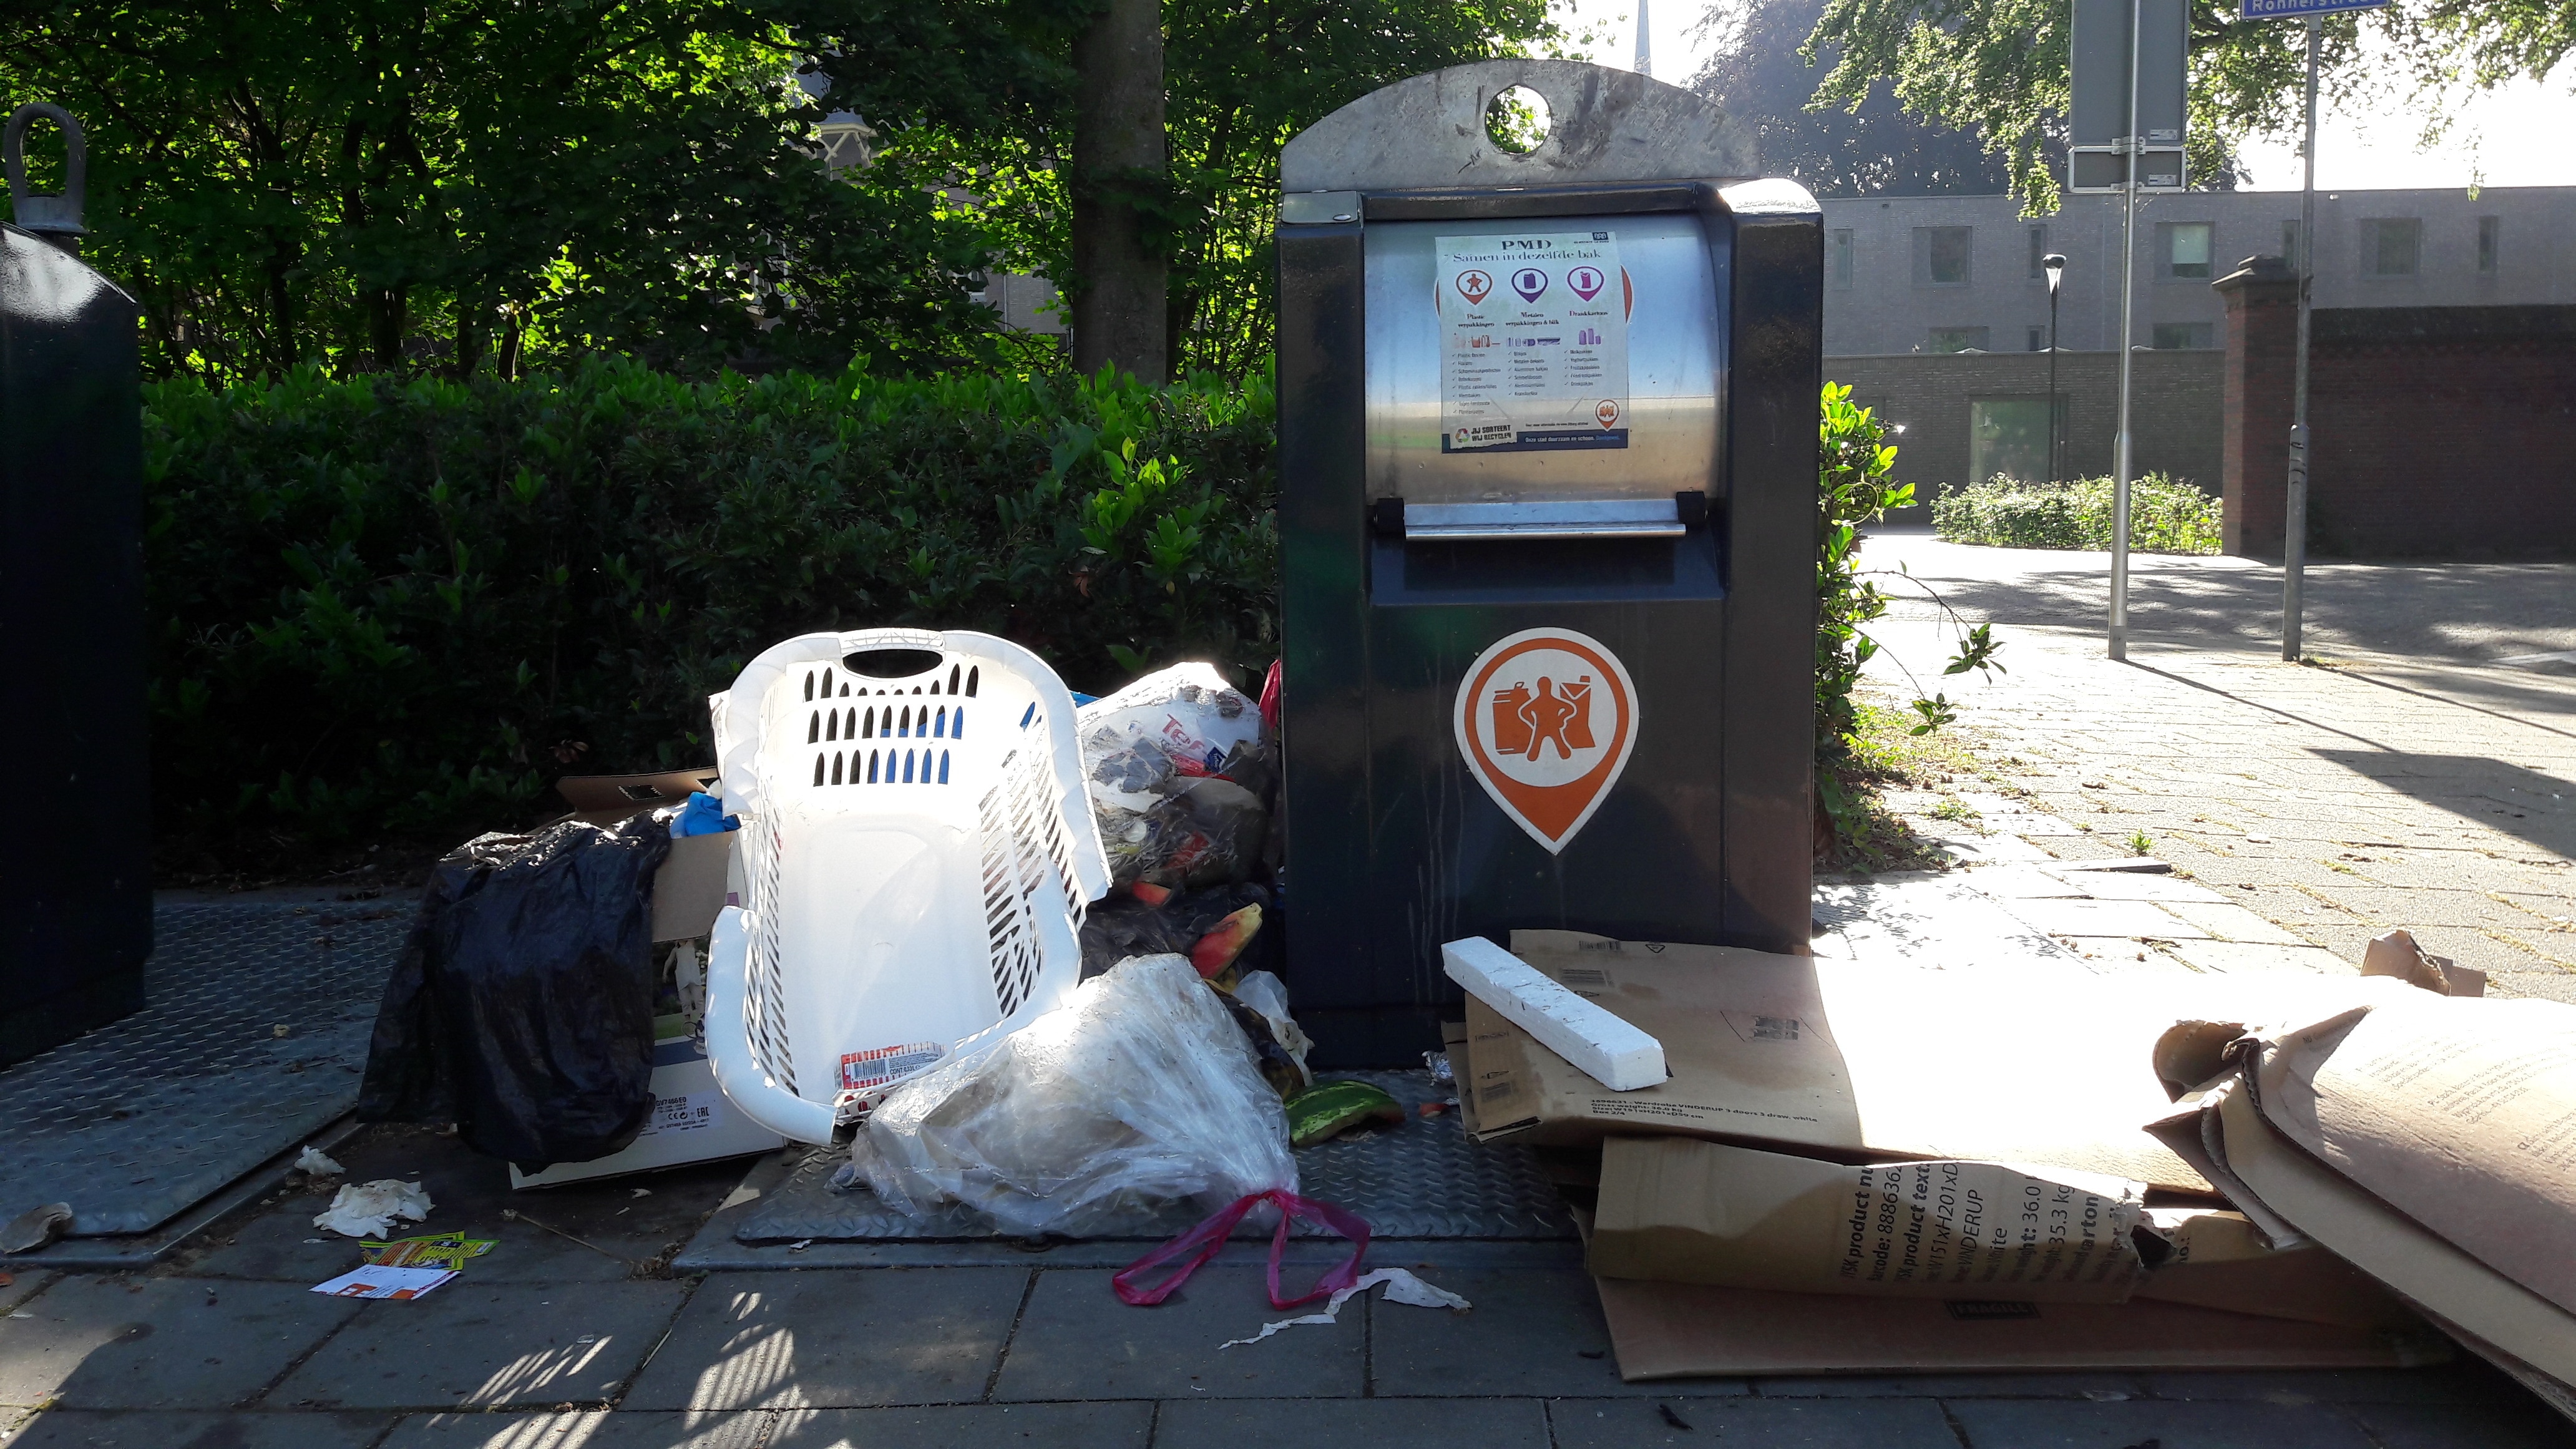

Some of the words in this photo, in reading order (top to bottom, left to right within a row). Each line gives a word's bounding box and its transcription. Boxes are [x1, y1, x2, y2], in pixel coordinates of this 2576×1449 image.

[1453, 253, 1499, 262] Samen
[1503, 252, 1515, 261] in
[1518, 250, 1574, 260] dezelfde
[1578, 249, 1601, 258] bak
[1501, 240, 1551, 250] PMD
[1482, 425, 1511, 433] SORTEERT
[1679, 1103, 1723, 1111] VINDERUP
[2022, 1186, 2041, 1222] 36.0
[1849, 1191, 1870, 1258] product
[1903, 1204, 1926, 1266] product
[1958, 1189, 1983, 1266] VINDERUP
[2048, 1209, 2067, 1244] 35.3
